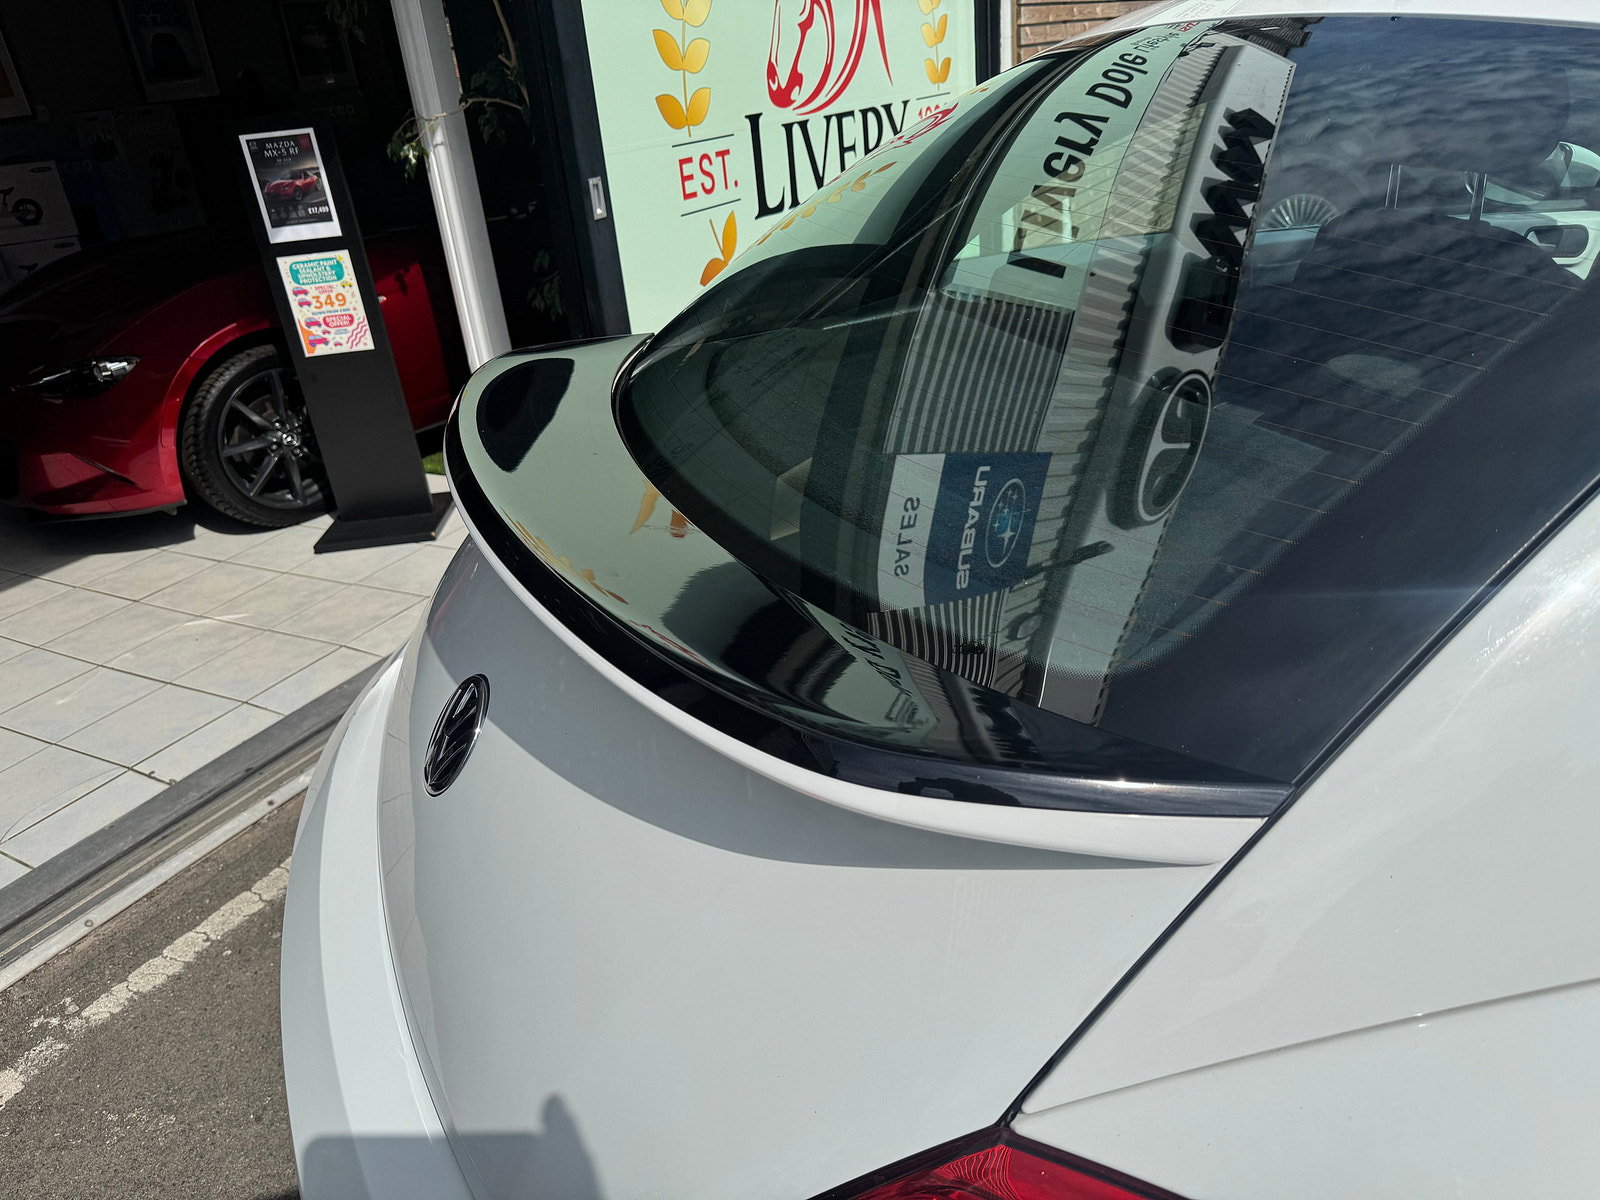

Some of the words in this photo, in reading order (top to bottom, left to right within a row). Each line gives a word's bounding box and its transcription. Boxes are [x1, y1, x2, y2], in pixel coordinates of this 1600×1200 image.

[265, 140, 296, 150] MAZDA
[264, 149, 287, 158] MX-5
[289, 147, 300, 155] RF
[678, 148, 739, 201] EST.
[292, 260, 319, 271] CERAMIC
[319, 259, 338, 267] PAINT
[300, 276, 338, 284] PROTECTION
[312, 293, 347, 309] 349
